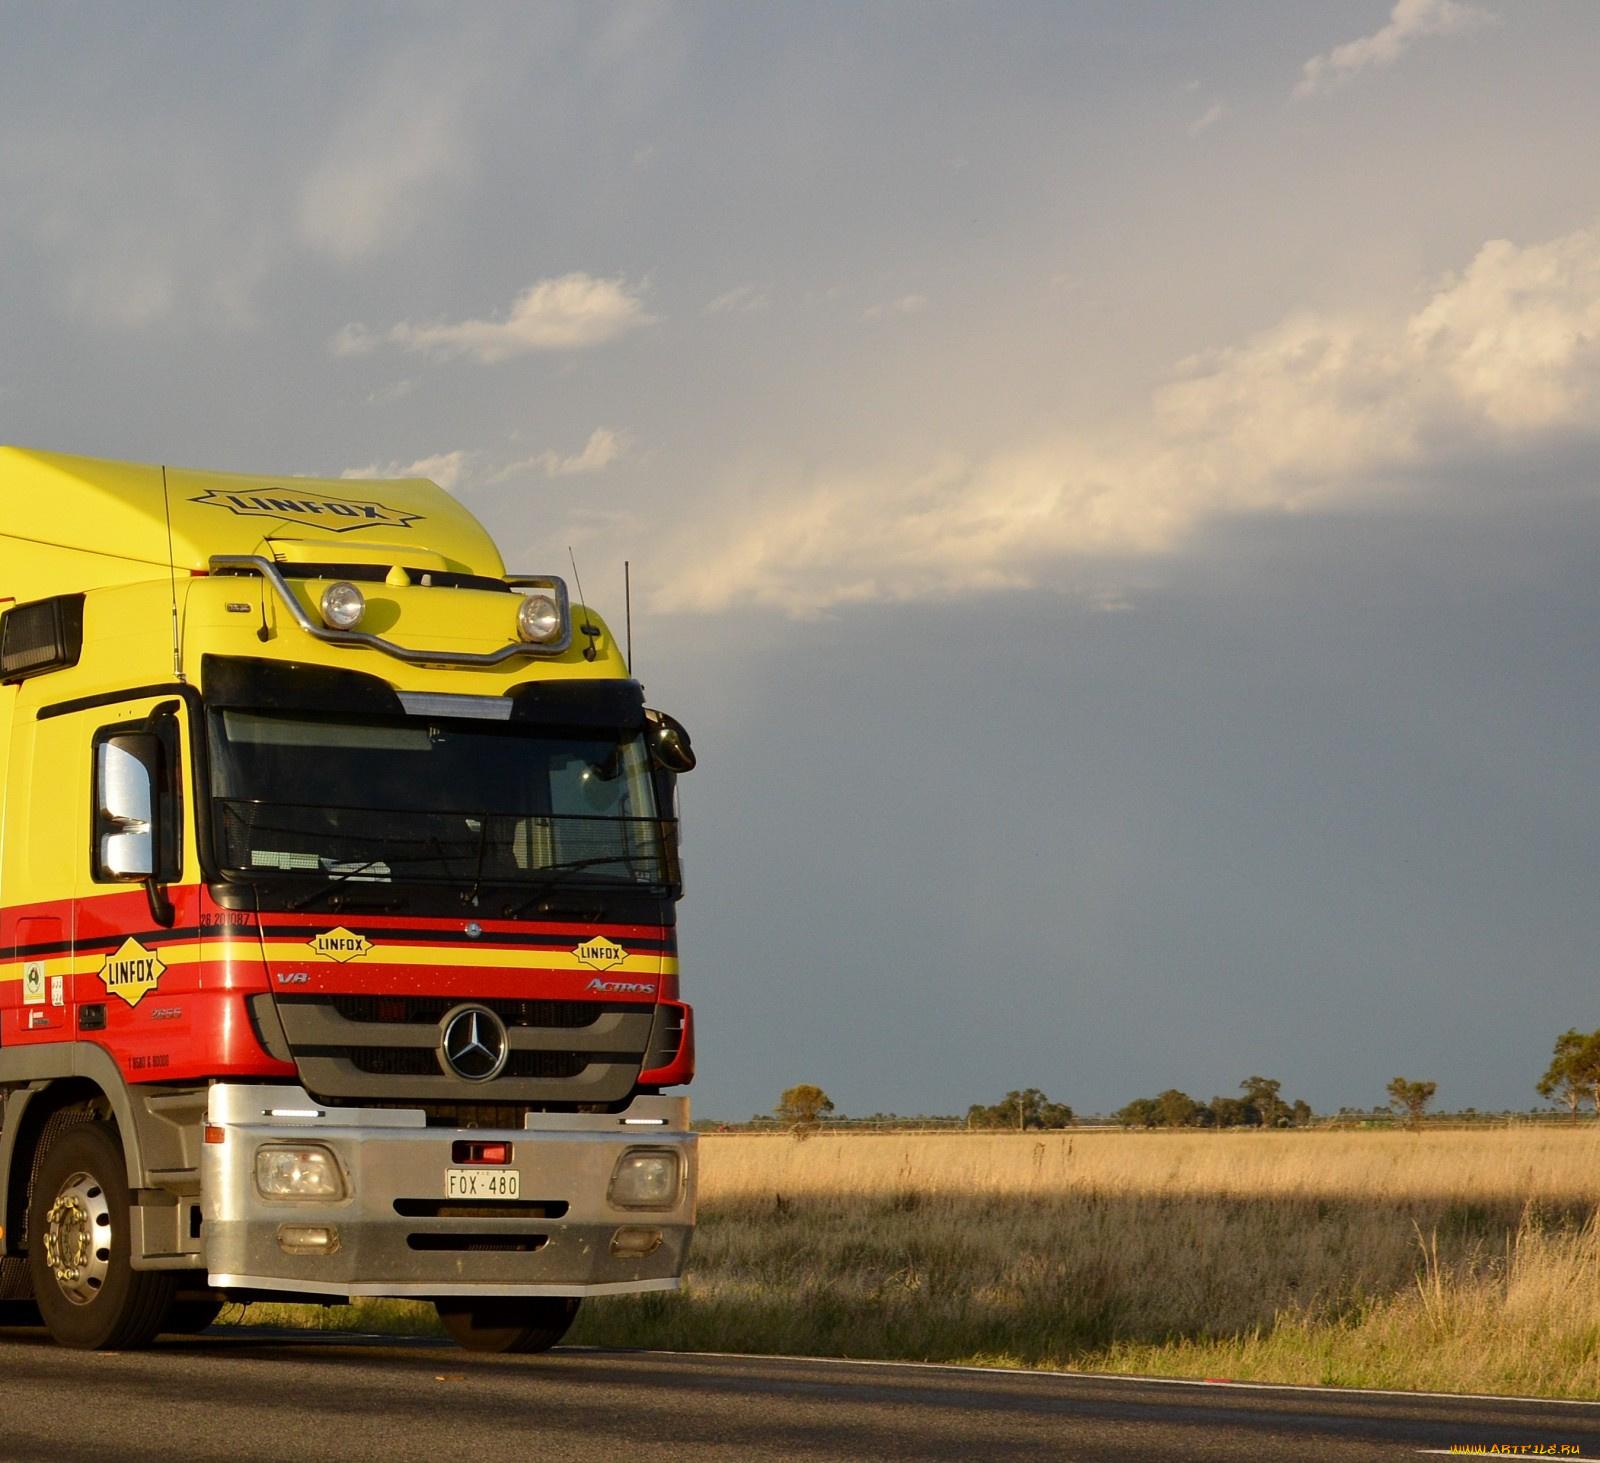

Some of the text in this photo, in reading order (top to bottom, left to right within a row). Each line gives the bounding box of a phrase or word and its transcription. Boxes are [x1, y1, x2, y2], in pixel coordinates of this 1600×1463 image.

[226, 495, 391, 520] LINFOX
[319, 938, 363, 951] LINFOX
[581, 947, 620, 960] LINFOX
[109, 959, 154, 985] LINFOX
[277, 973, 309, 984] V8
